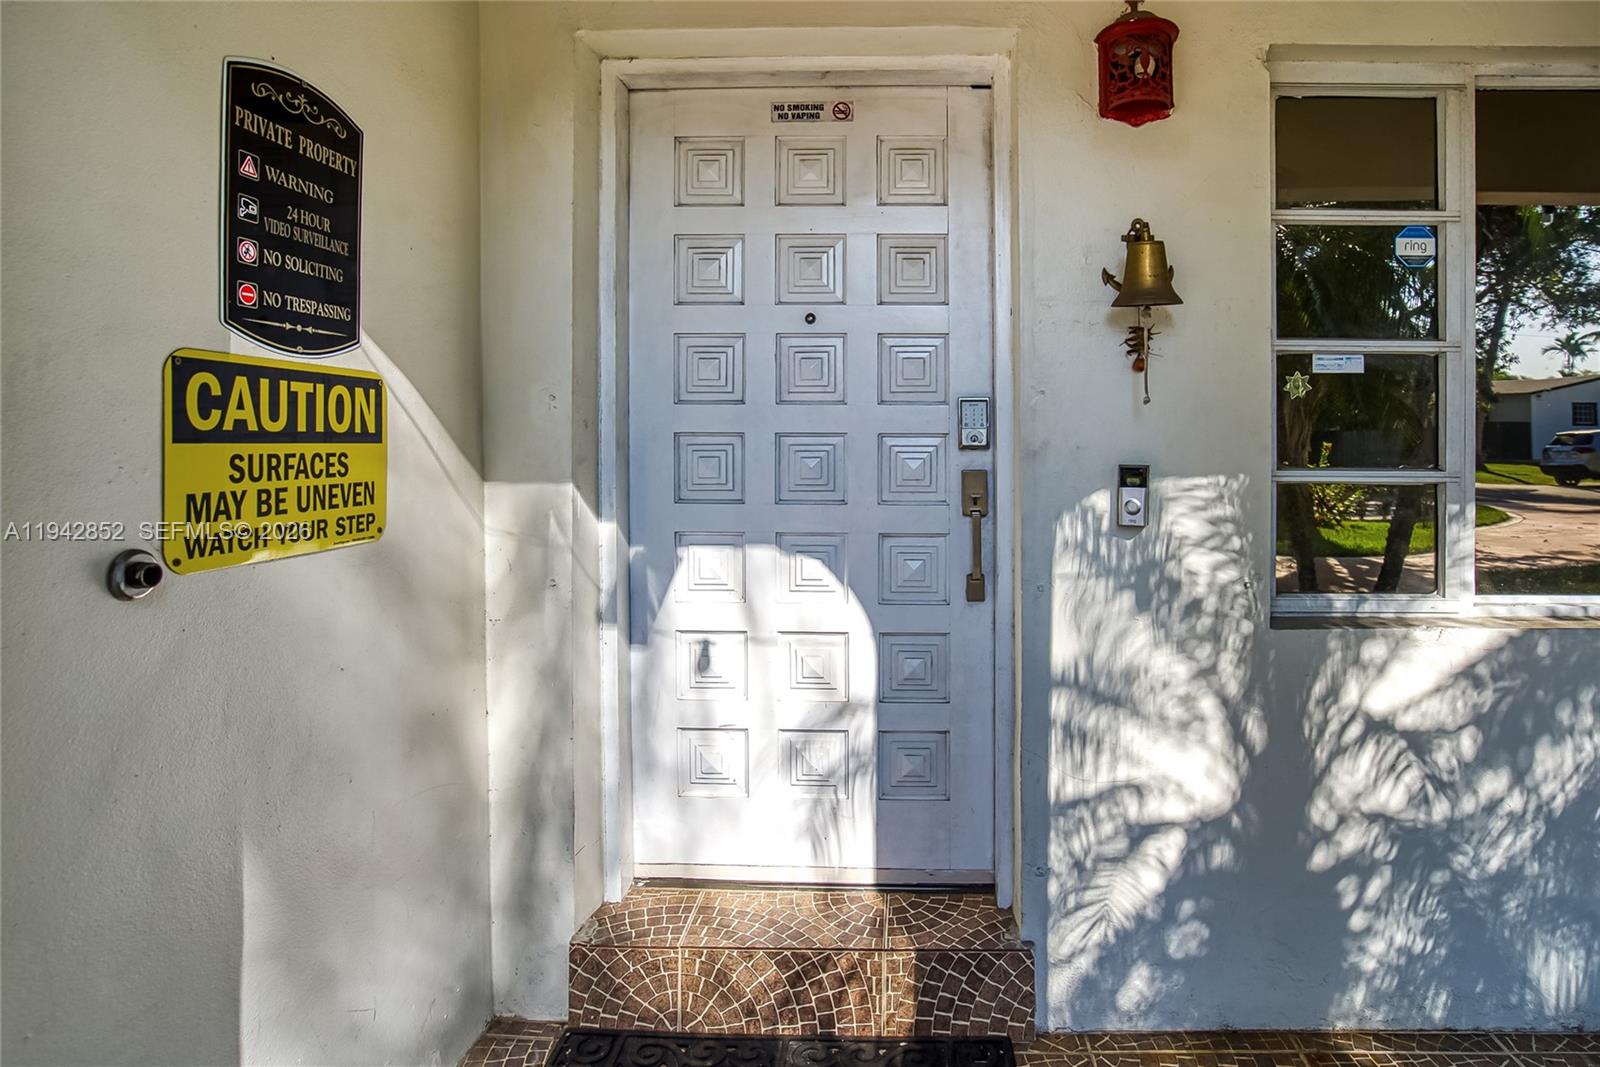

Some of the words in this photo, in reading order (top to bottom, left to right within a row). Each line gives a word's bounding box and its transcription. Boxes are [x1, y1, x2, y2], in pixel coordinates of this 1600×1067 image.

[773, 104, 785, 112] NO
[787, 104, 824, 112] SMOKING
[777, 112, 789, 120] NO
[791, 112, 821, 120] VAPING
[234, 105, 293, 149] PRIVATE
[299, 135, 357, 177] PROPERTY
[265, 165, 334, 204] WARNING
[264, 216, 291, 239] VIDEO
[293, 227, 349, 256] SURVEILLANCE
[287, 206, 299, 223] 24
[300, 210, 331, 233] HOUR
[1404, 240, 1427, 254] ring
[263, 249, 282, 267] NO
[285, 254, 343, 283] SOLICITING
[263, 290, 282, 308] NO
[284, 294, 351, 321] TRESPASSING
[185, 371, 376, 434] CAUTION
[228, 451, 350, 484] SURFACES
[185, 489, 248, 525] MAY
[256, 486, 288, 518] BE
[296, 480, 376, 513] UNEVEN
[335, 512, 376, 536] STEP
